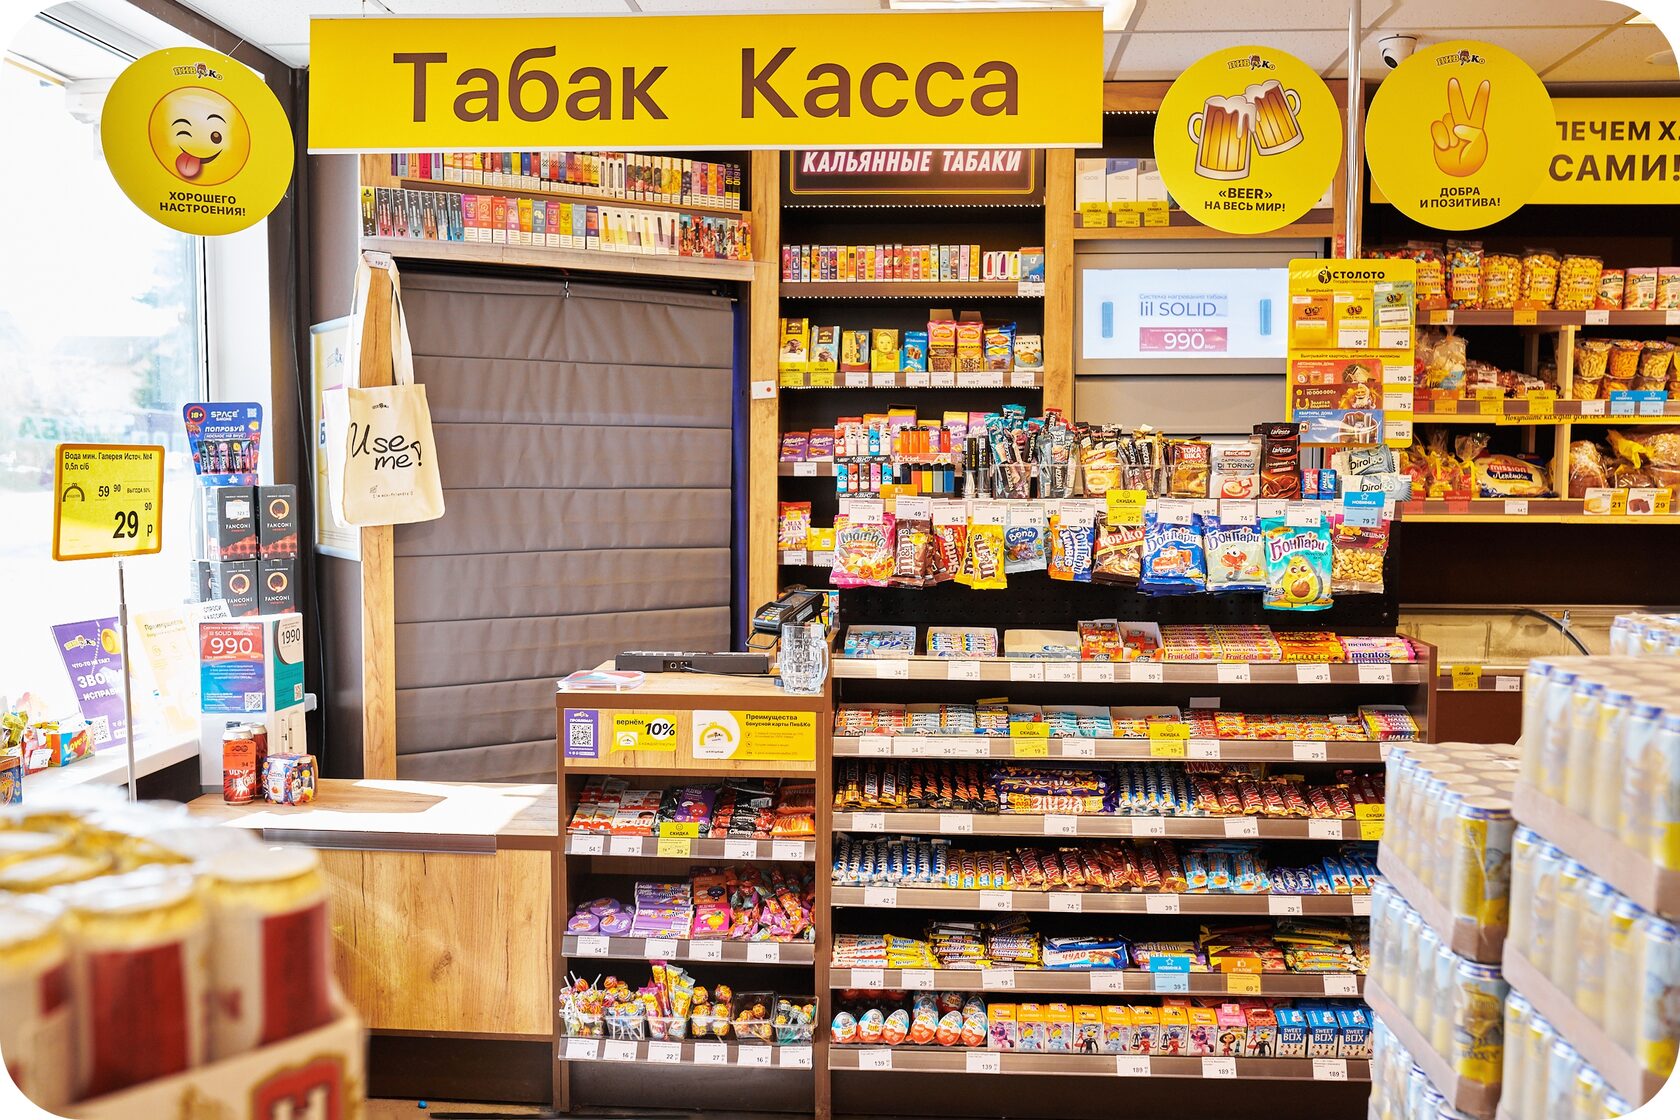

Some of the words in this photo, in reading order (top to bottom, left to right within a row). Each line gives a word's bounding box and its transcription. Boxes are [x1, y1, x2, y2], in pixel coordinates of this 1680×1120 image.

[393, 45, 669, 123] Табак
[741, 47, 1019, 119] Касса
[1658, 120, 1680, 141] Х
[802, 151, 931, 172] КАЛЬЯННЫЕ
[942, 150, 1022, 172] ТАБАКИ
[168, 191, 237, 204] ХОРОШЕГО
[1218, 188, 1273, 200] «BEER»
[1440, 186, 1481, 198] ДОБРА
[160, 202, 246, 217] НАСТРОЕНИЯ!
[1204, 201, 1220, 210] НА
[1223, 202, 1254, 211] ВЕСЬ
[1255, 202, 1286, 212] МИР!
[1420, 199, 1428, 208] И
[1430, 198, 1501, 208] ПОЗИТИВА!
[1332, 270, 1386, 280] СТОЛОТО
[1160, 302, 1216, 317] SOLID
[1164, 332, 1204, 350] 990
[210, 410, 238, 418] SPACE
[204, 424, 244, 432] ПОПРОБУЙ
[350, 422, 410, 458] Use
[64, 452, 81, 460] Вода
[98, 452, 122, 462] Галерея
[1350, 457, 1371, 470] Dirol
[80, 462, 90, 470] с/б
[1490, 464, 1527, 472] mission
[98, 486, 110, 498] 59
[113, 484, 122, 492] 90
[1362, 483, 1382, 492] Dirol
[144, 502, 152, 510] 90
[112, 510, 138, 538] 29
[840, 530, 886, 547] Mamba
[1100, 530, 1144, 547] KOPIKO
[1144, 529, 1198, 552] БонПари
[1205, 529, 1260, 551] БонПари
[1270, 535, 1326, 562] БонПари
[282, 628, 300, 644] 1990
[210, 638, 253, 654] 990
[1168, 652, 1198, 660] Fruit-tella
[644, 722, 676, 736] 10%
[1062, 952, 1086, 960] ЧУДО
[1314, 1034, 1334, 1042] BOX
